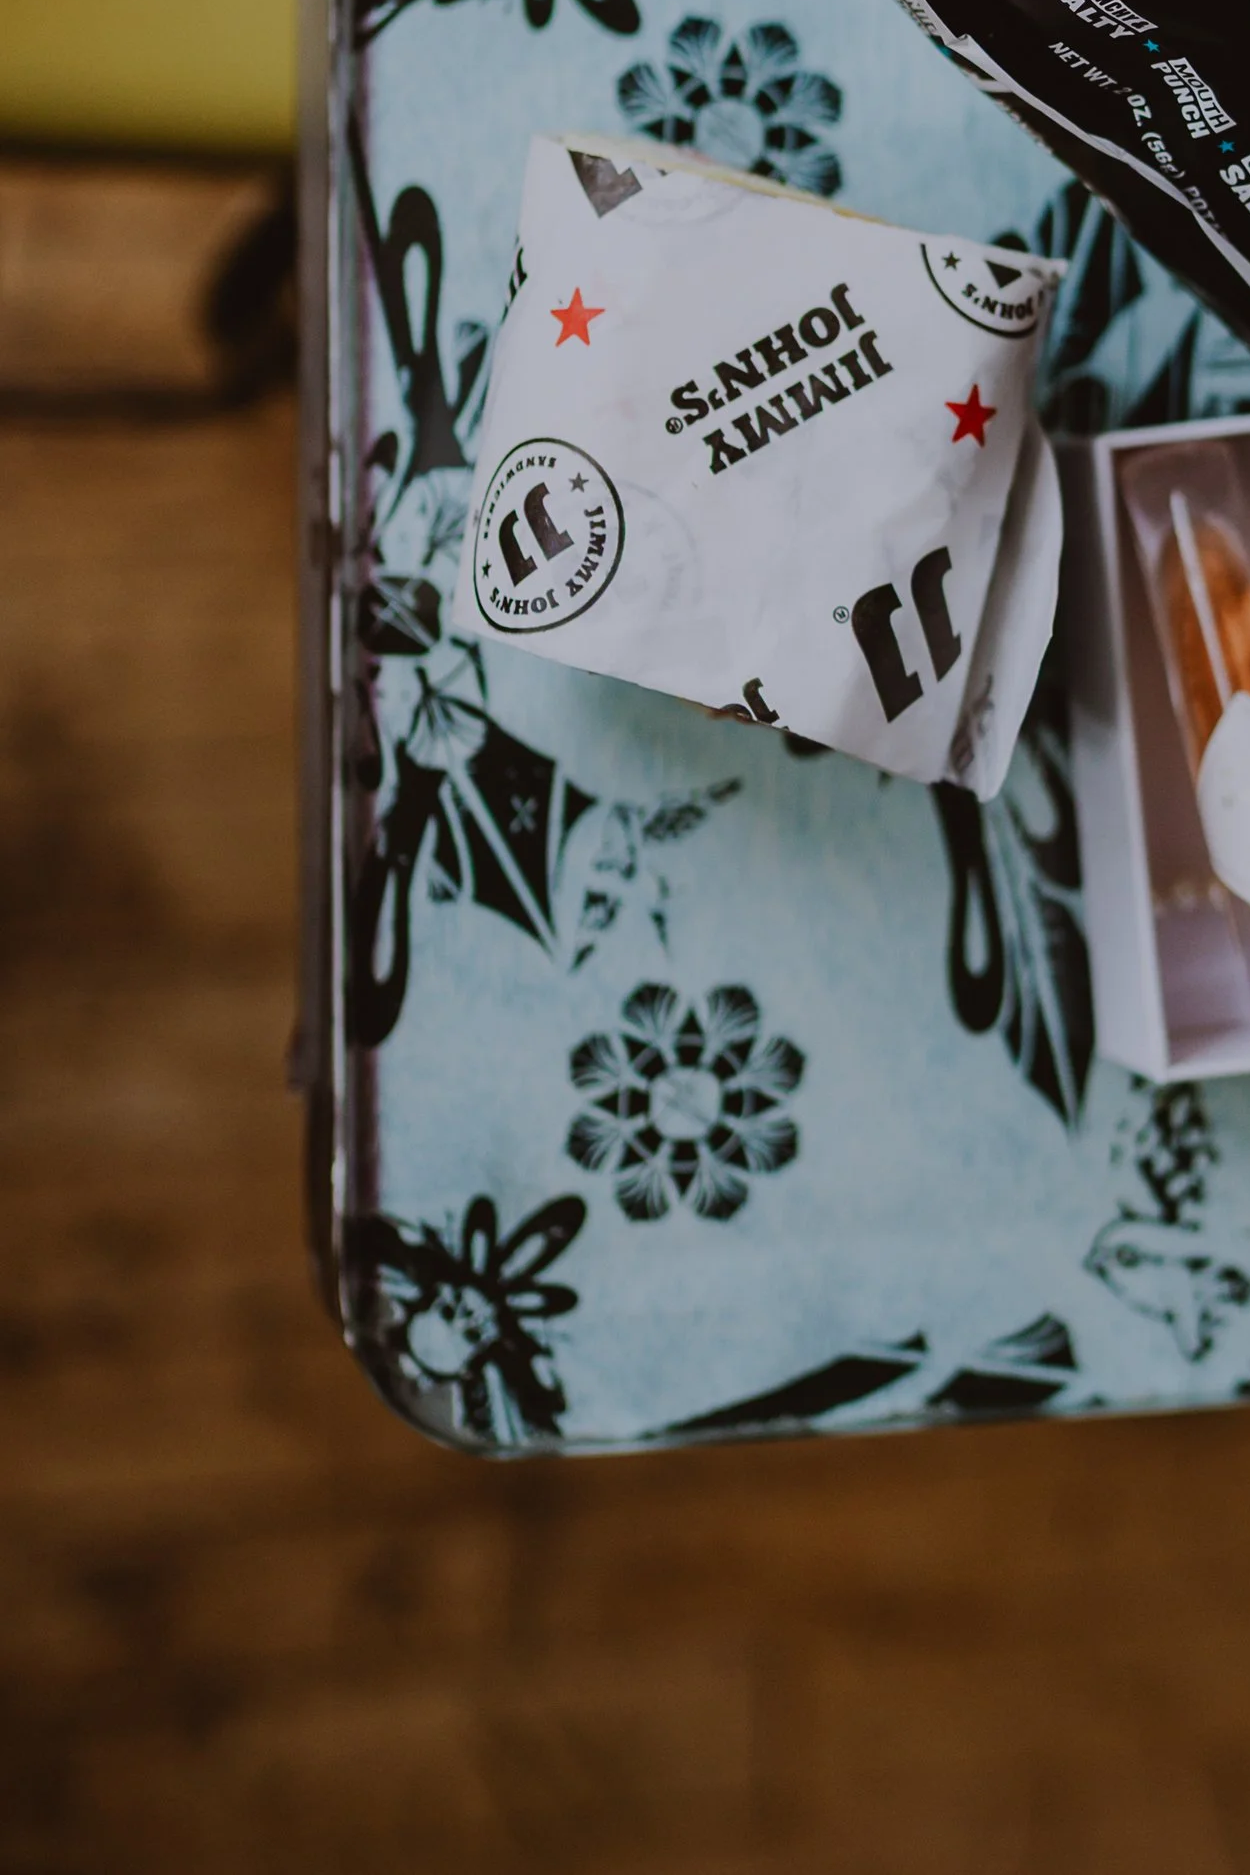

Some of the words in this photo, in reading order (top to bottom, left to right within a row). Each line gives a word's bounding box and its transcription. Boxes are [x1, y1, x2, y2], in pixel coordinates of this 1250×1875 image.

[1047, 41, 1090, 69] NET
[1126, 93, 1153, 128] OZ.
[1150, 61, 1211, 140] PUNCH
[1173, 62, 1231, 129] MOUTH
[962, 283, 1035, 320] JOHN'S
[669, 282, 866, 427] JOHN'S
[701, 329, 894, 476] JIMMY
[498, 481, 575, 588] JJ
[565, 505, 607, 598] JIMMY
[489, 586, 561, 616] JOHN'S
